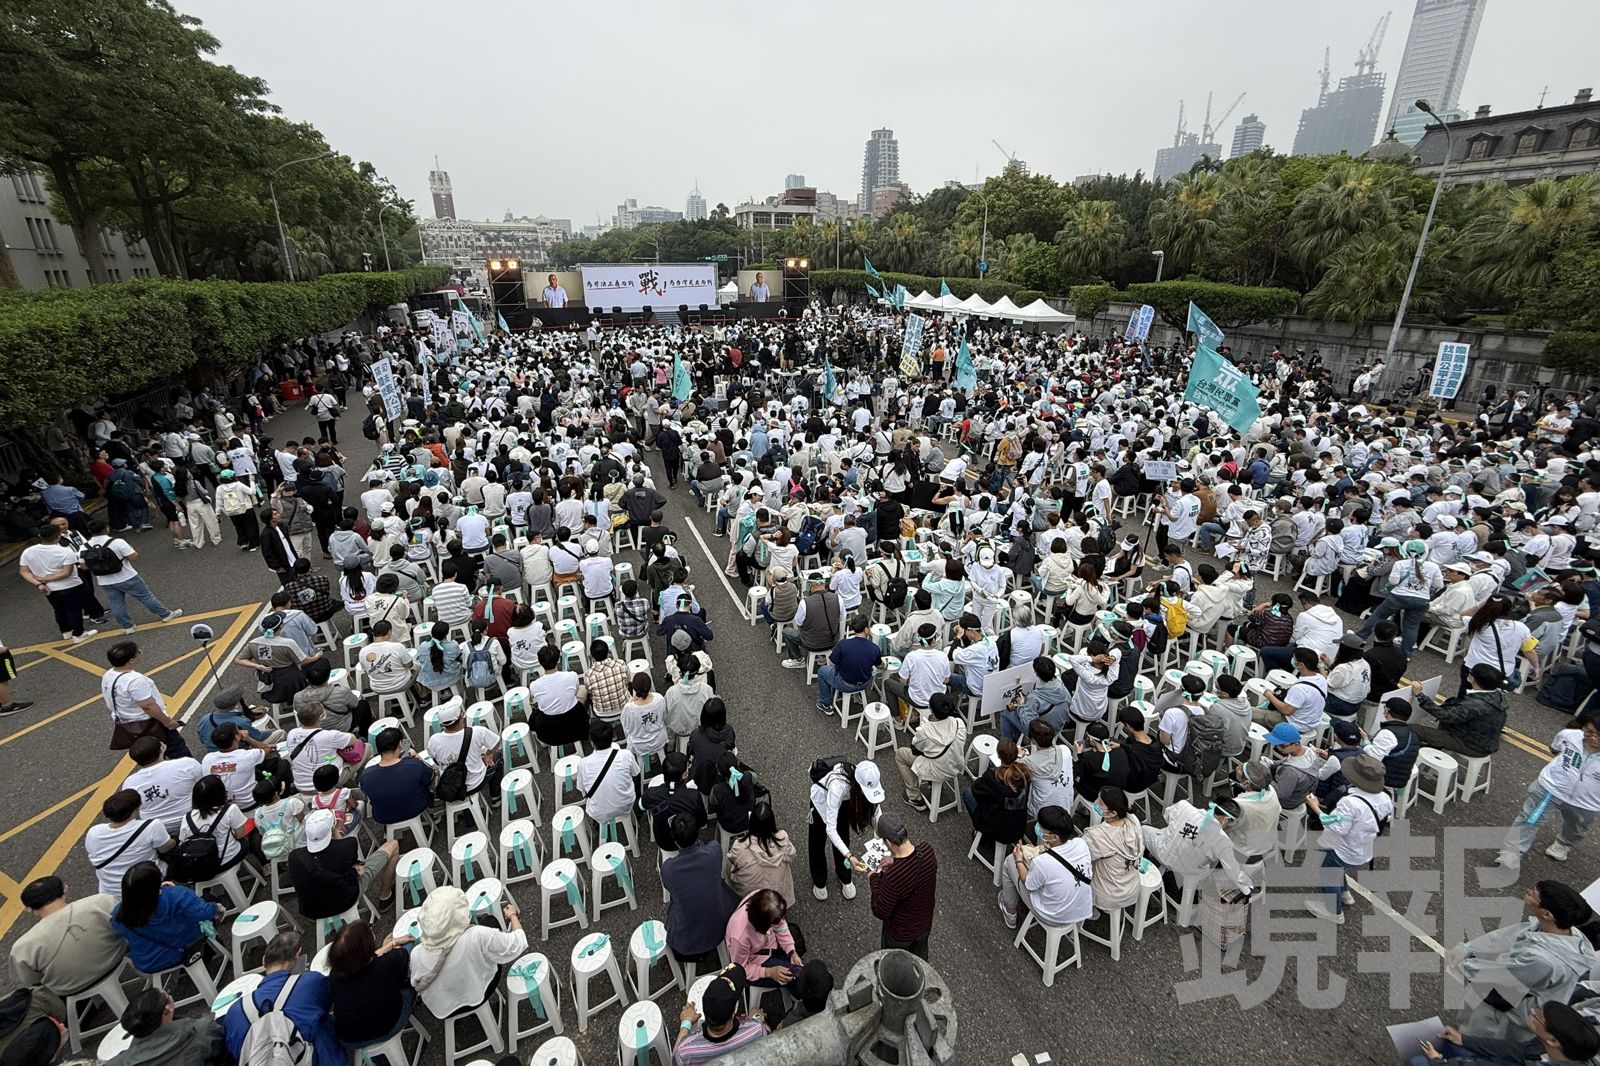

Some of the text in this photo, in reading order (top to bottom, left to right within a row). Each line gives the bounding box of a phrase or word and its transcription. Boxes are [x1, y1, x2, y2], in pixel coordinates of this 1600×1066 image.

[1195, 378, 1241, 408] 台灣民眾黨
